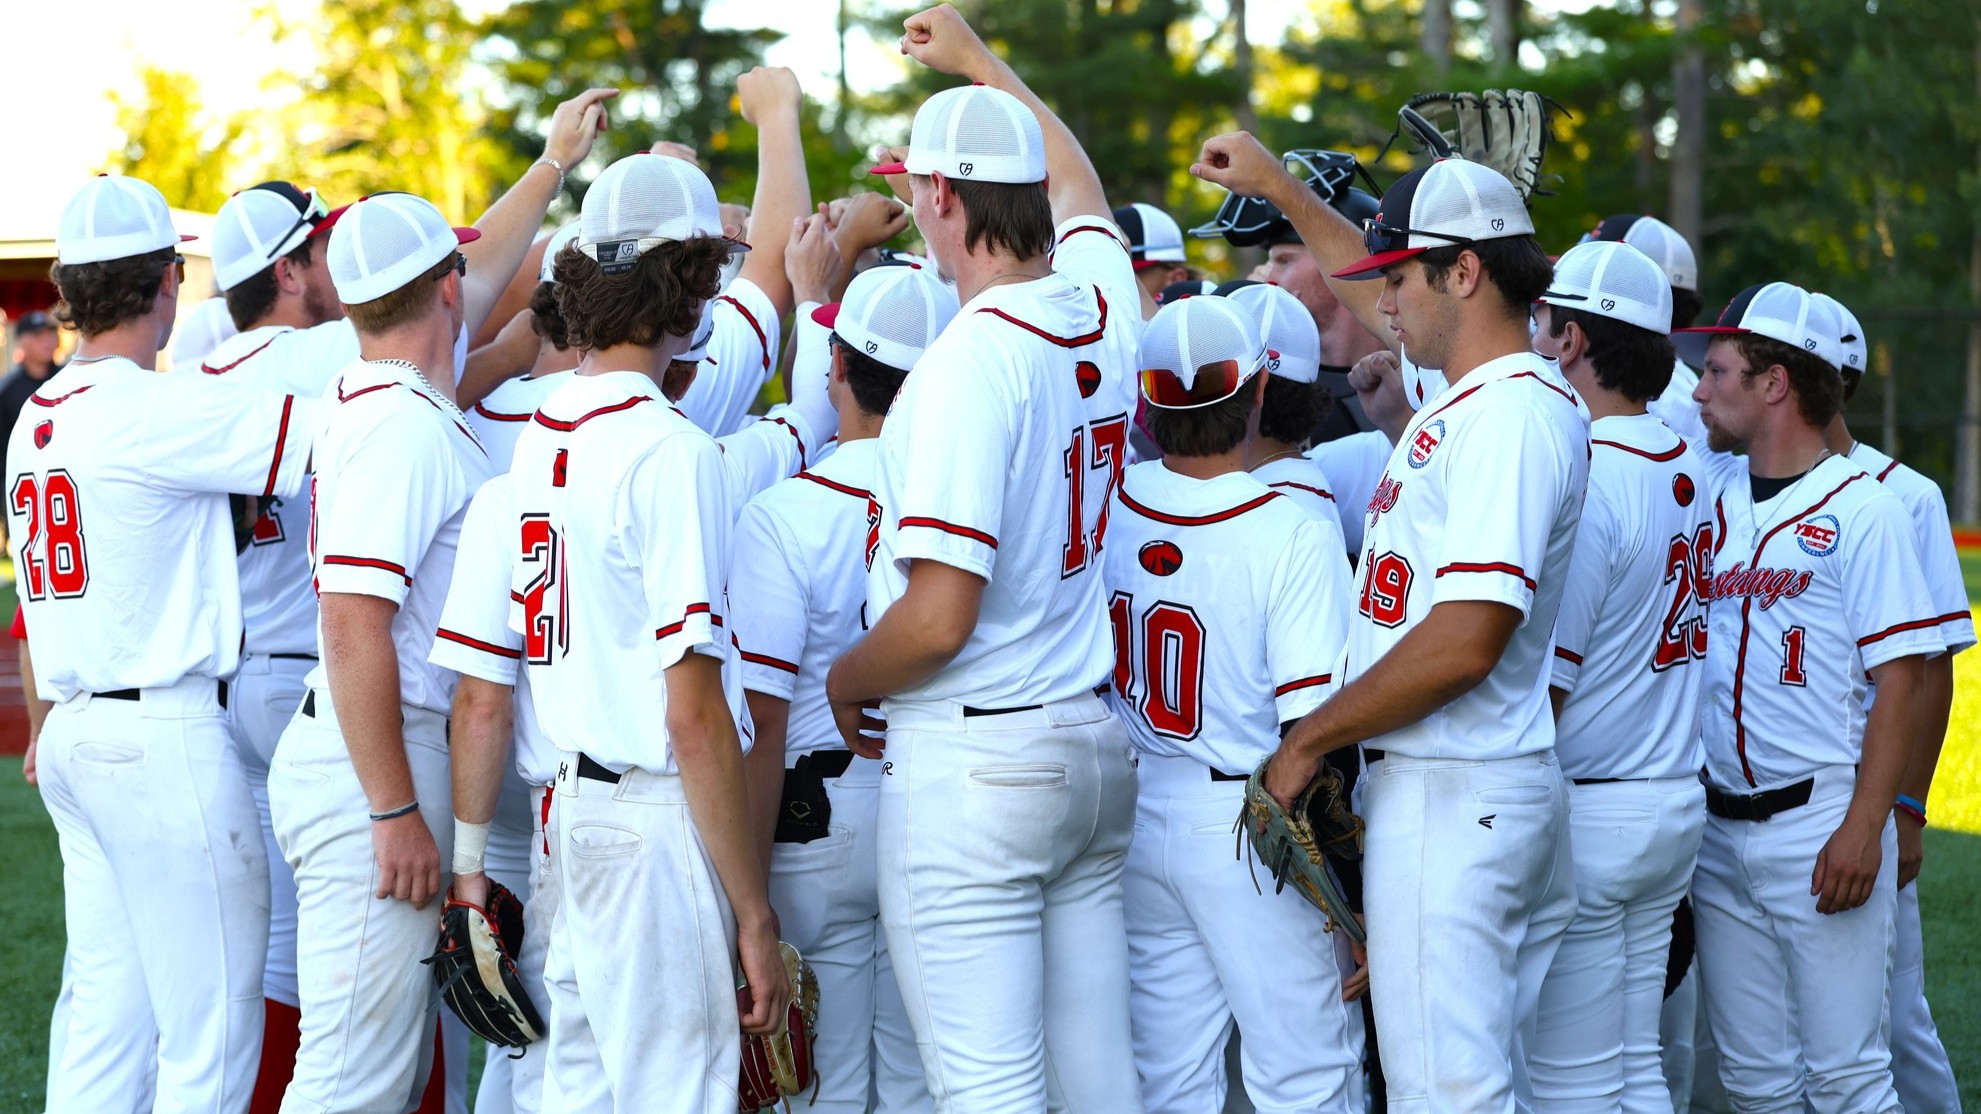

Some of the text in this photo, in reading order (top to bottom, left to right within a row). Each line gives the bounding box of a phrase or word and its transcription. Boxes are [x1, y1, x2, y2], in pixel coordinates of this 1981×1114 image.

[10, 468, 90, 602] 28
[1061, 411, 1128, 580] 17
[1794, 523, 1836, 544] YSCC
[1359, 541, 1415, 629] 19
[1651, 521, 1711, 673] 29
[1710, 561, 1814, 611] stangs
[1108, 590, 1207, 742] 10
[1779, 625, 1806, 688] 1
